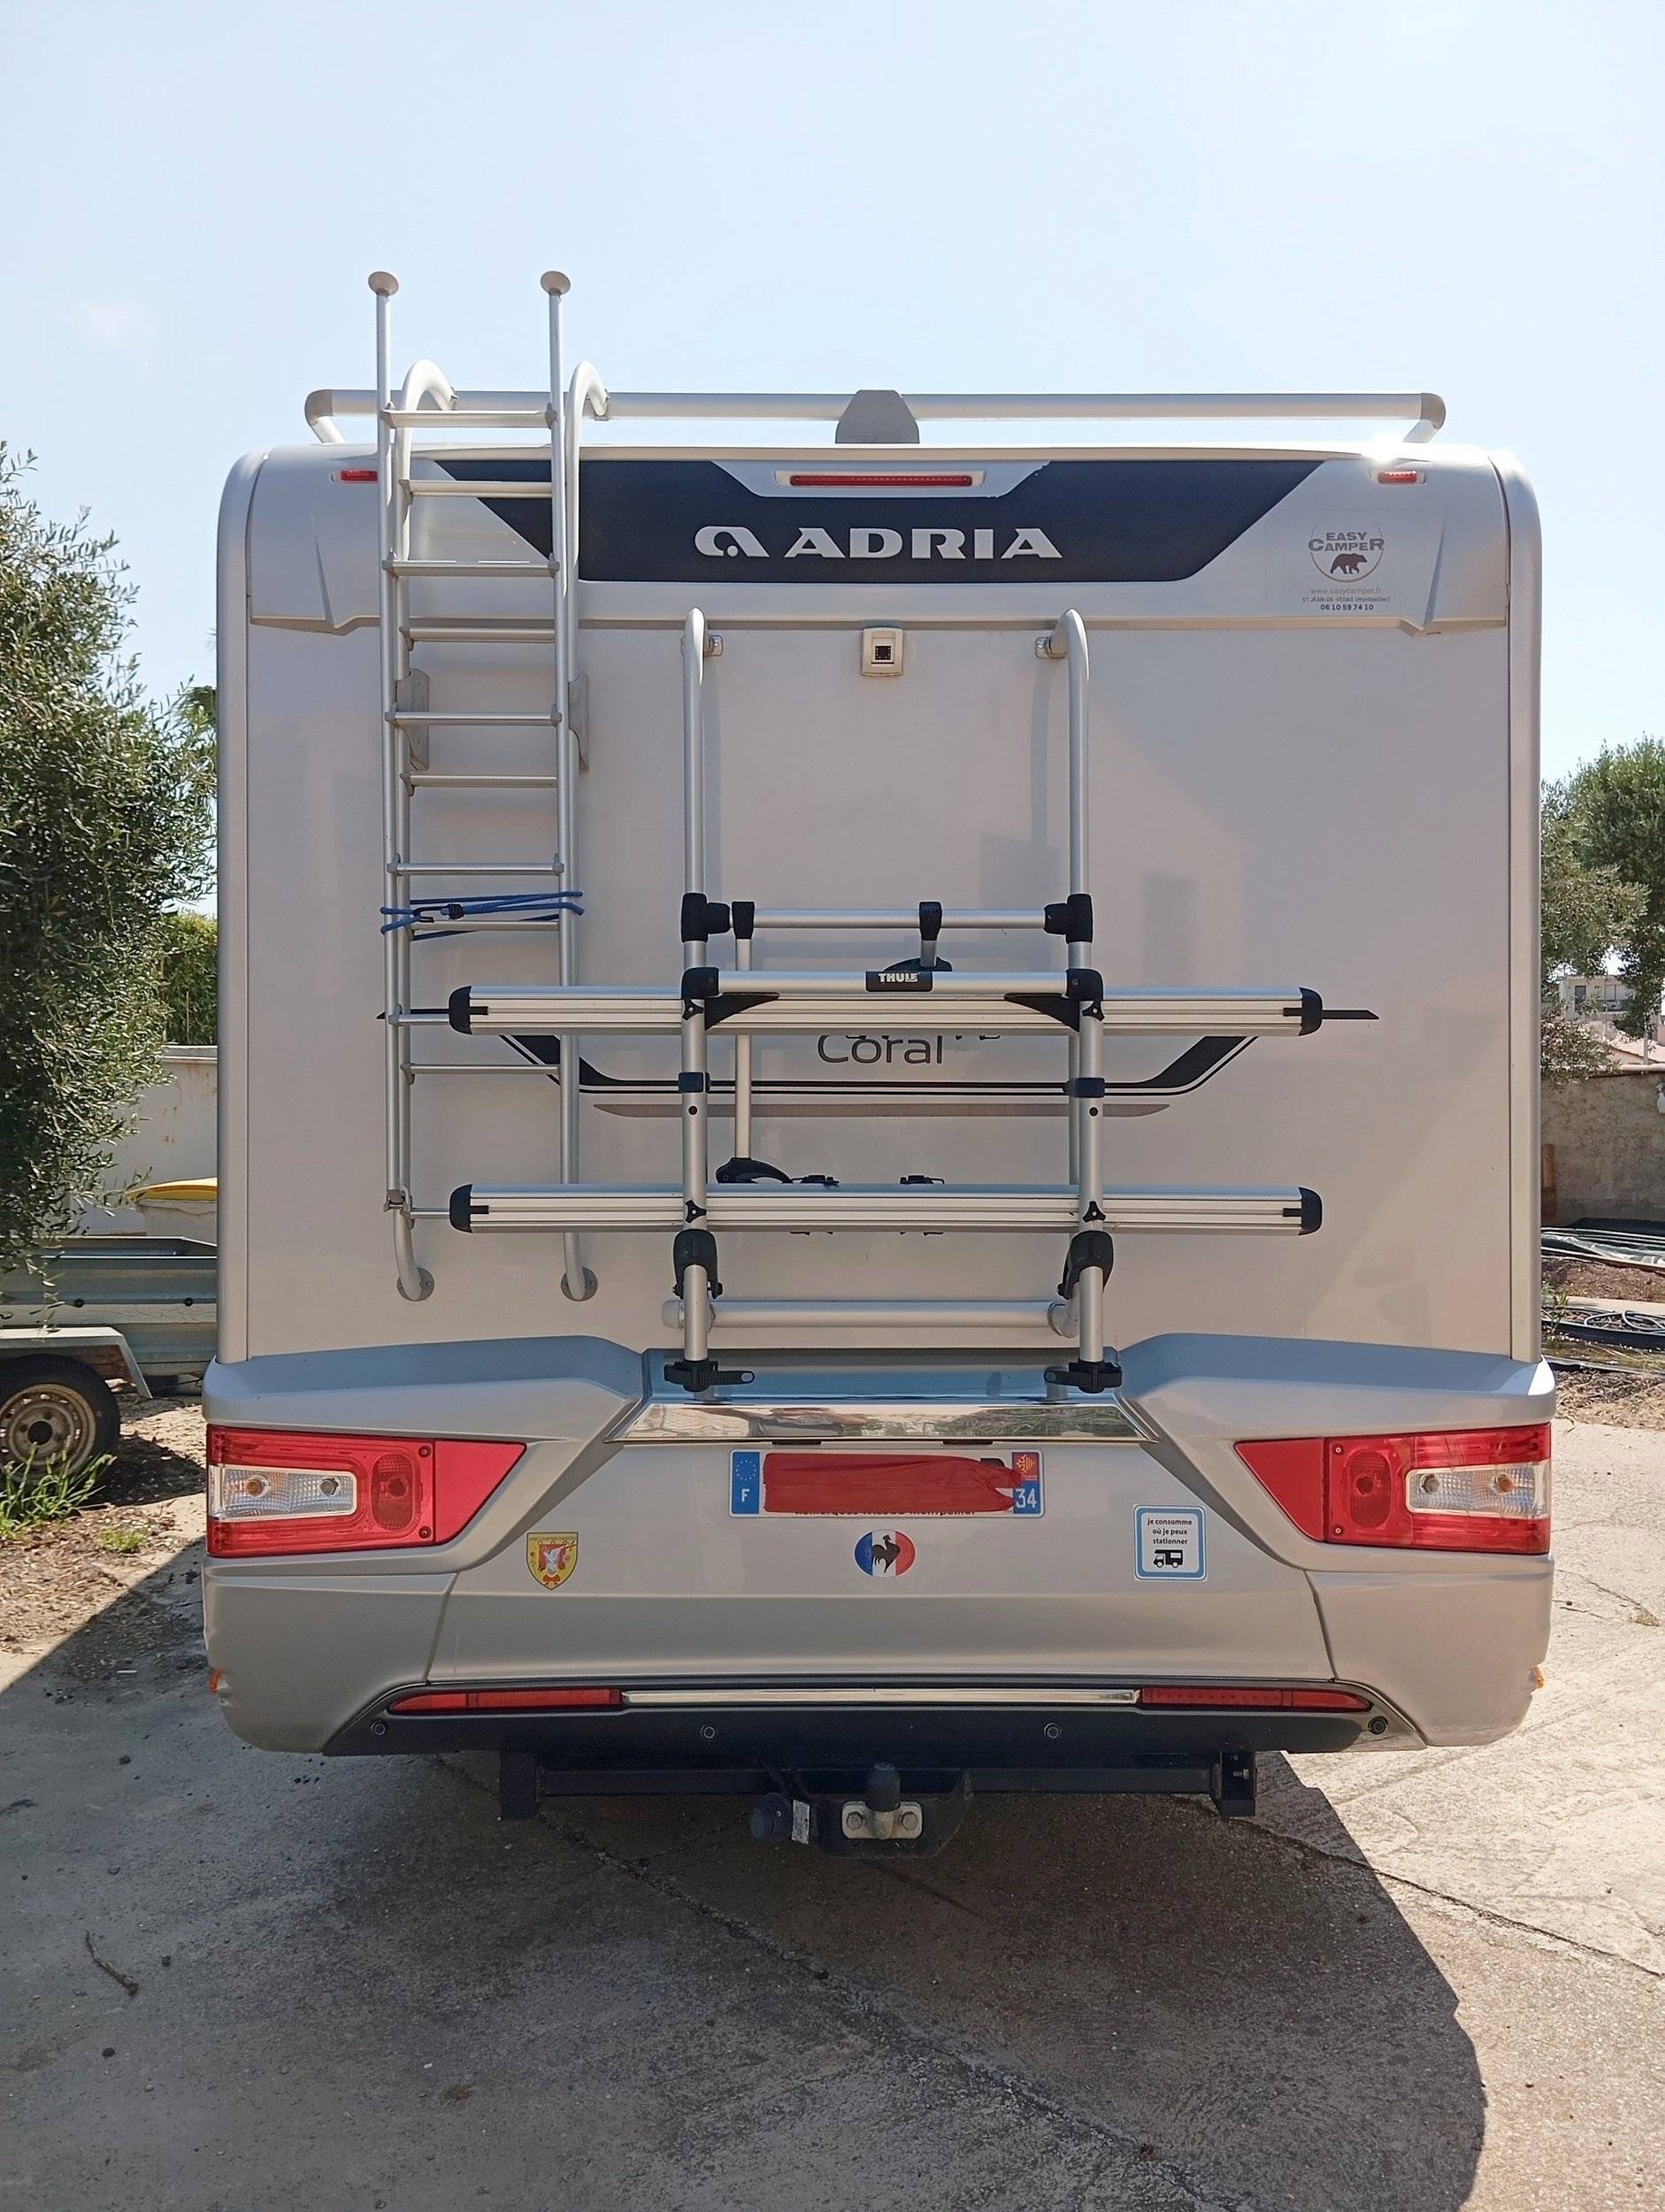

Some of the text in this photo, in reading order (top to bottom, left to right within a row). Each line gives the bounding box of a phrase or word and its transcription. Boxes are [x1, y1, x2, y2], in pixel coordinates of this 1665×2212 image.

[784, 527, 1063, 559] ADRIA
[1326, 532, 1367, 541] EASY
[1308, 538, 1385, 551] CAMPER
[878, 972, 918, 983] THULE
[817, 1034, 943, 1064] Coral
[740, 1488, 750, 1502] F
[1015, 1487, 1038, 1509] 34
[1147, 1517, 1154, 1526] je
